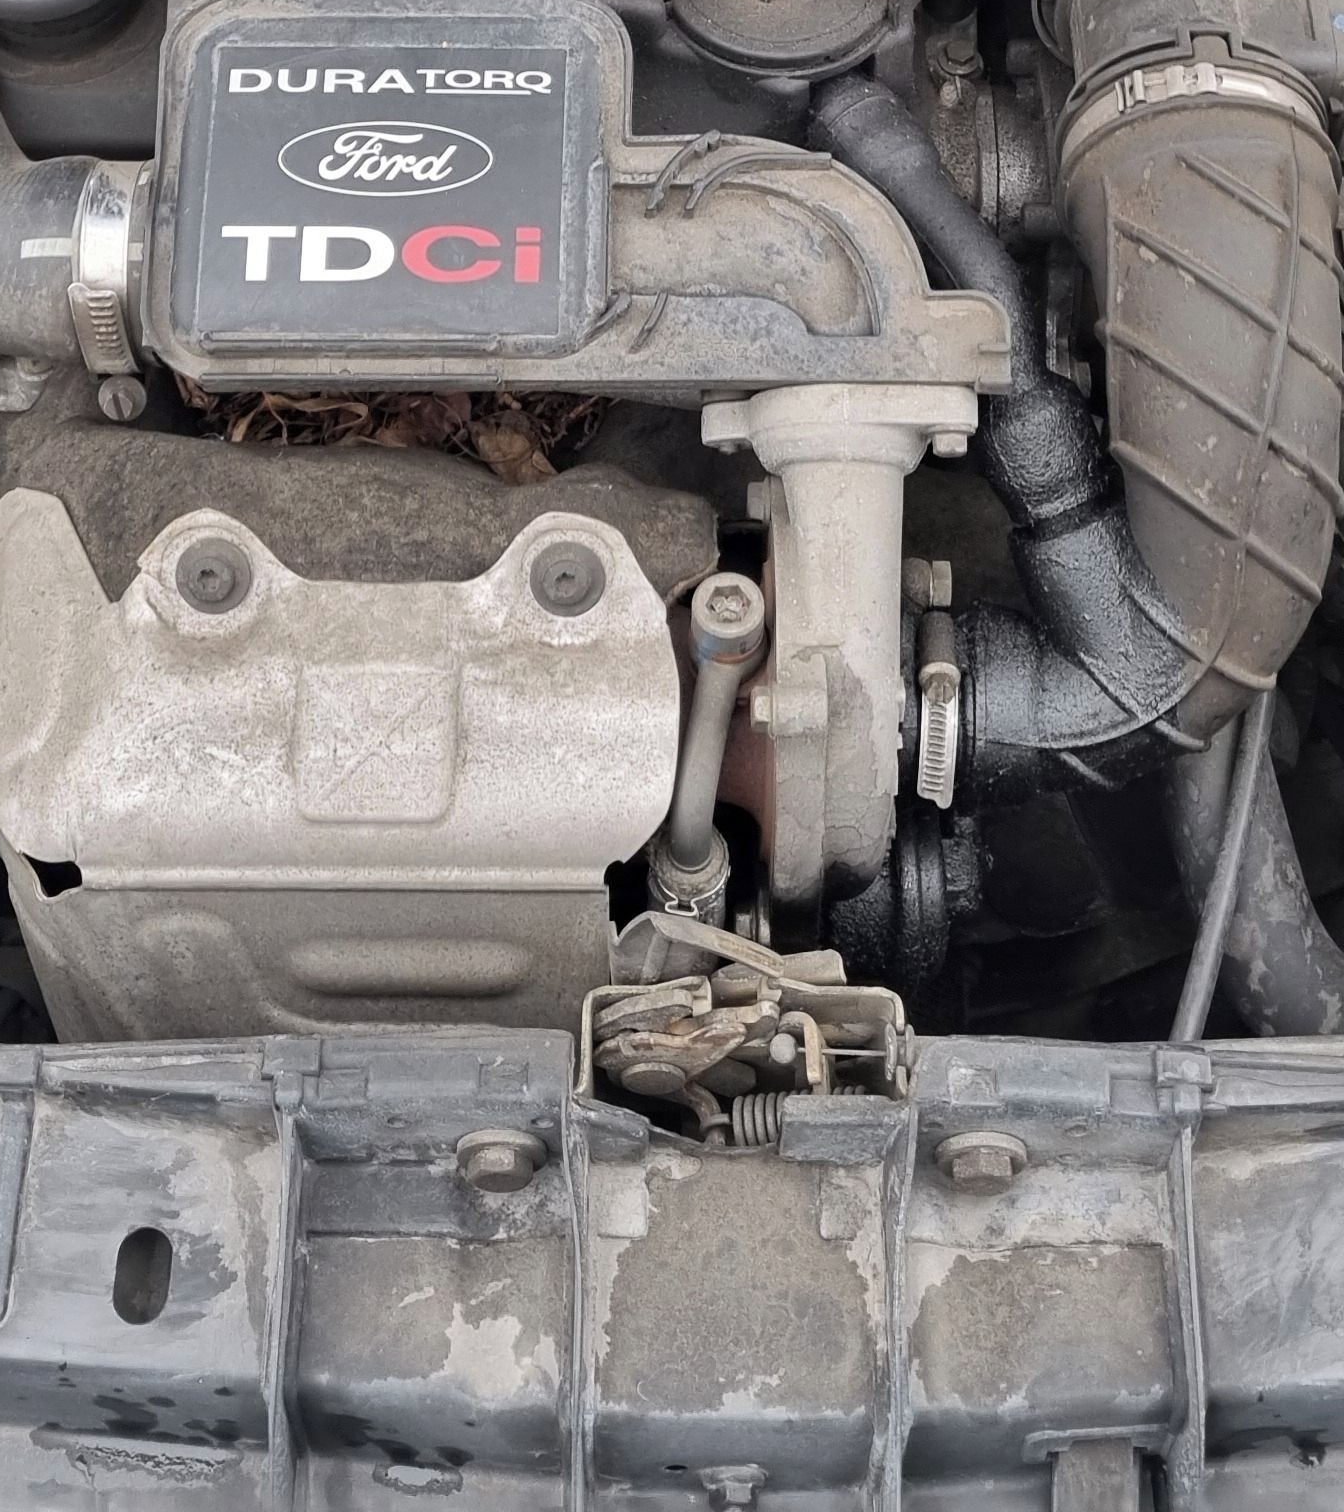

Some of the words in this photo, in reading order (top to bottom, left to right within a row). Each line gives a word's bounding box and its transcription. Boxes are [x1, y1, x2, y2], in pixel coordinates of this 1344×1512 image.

[228, 68, 552, 95] DURATORQ
[318, 129, 458, 182] Ford
[220, 224, 542, 284] TDCi
